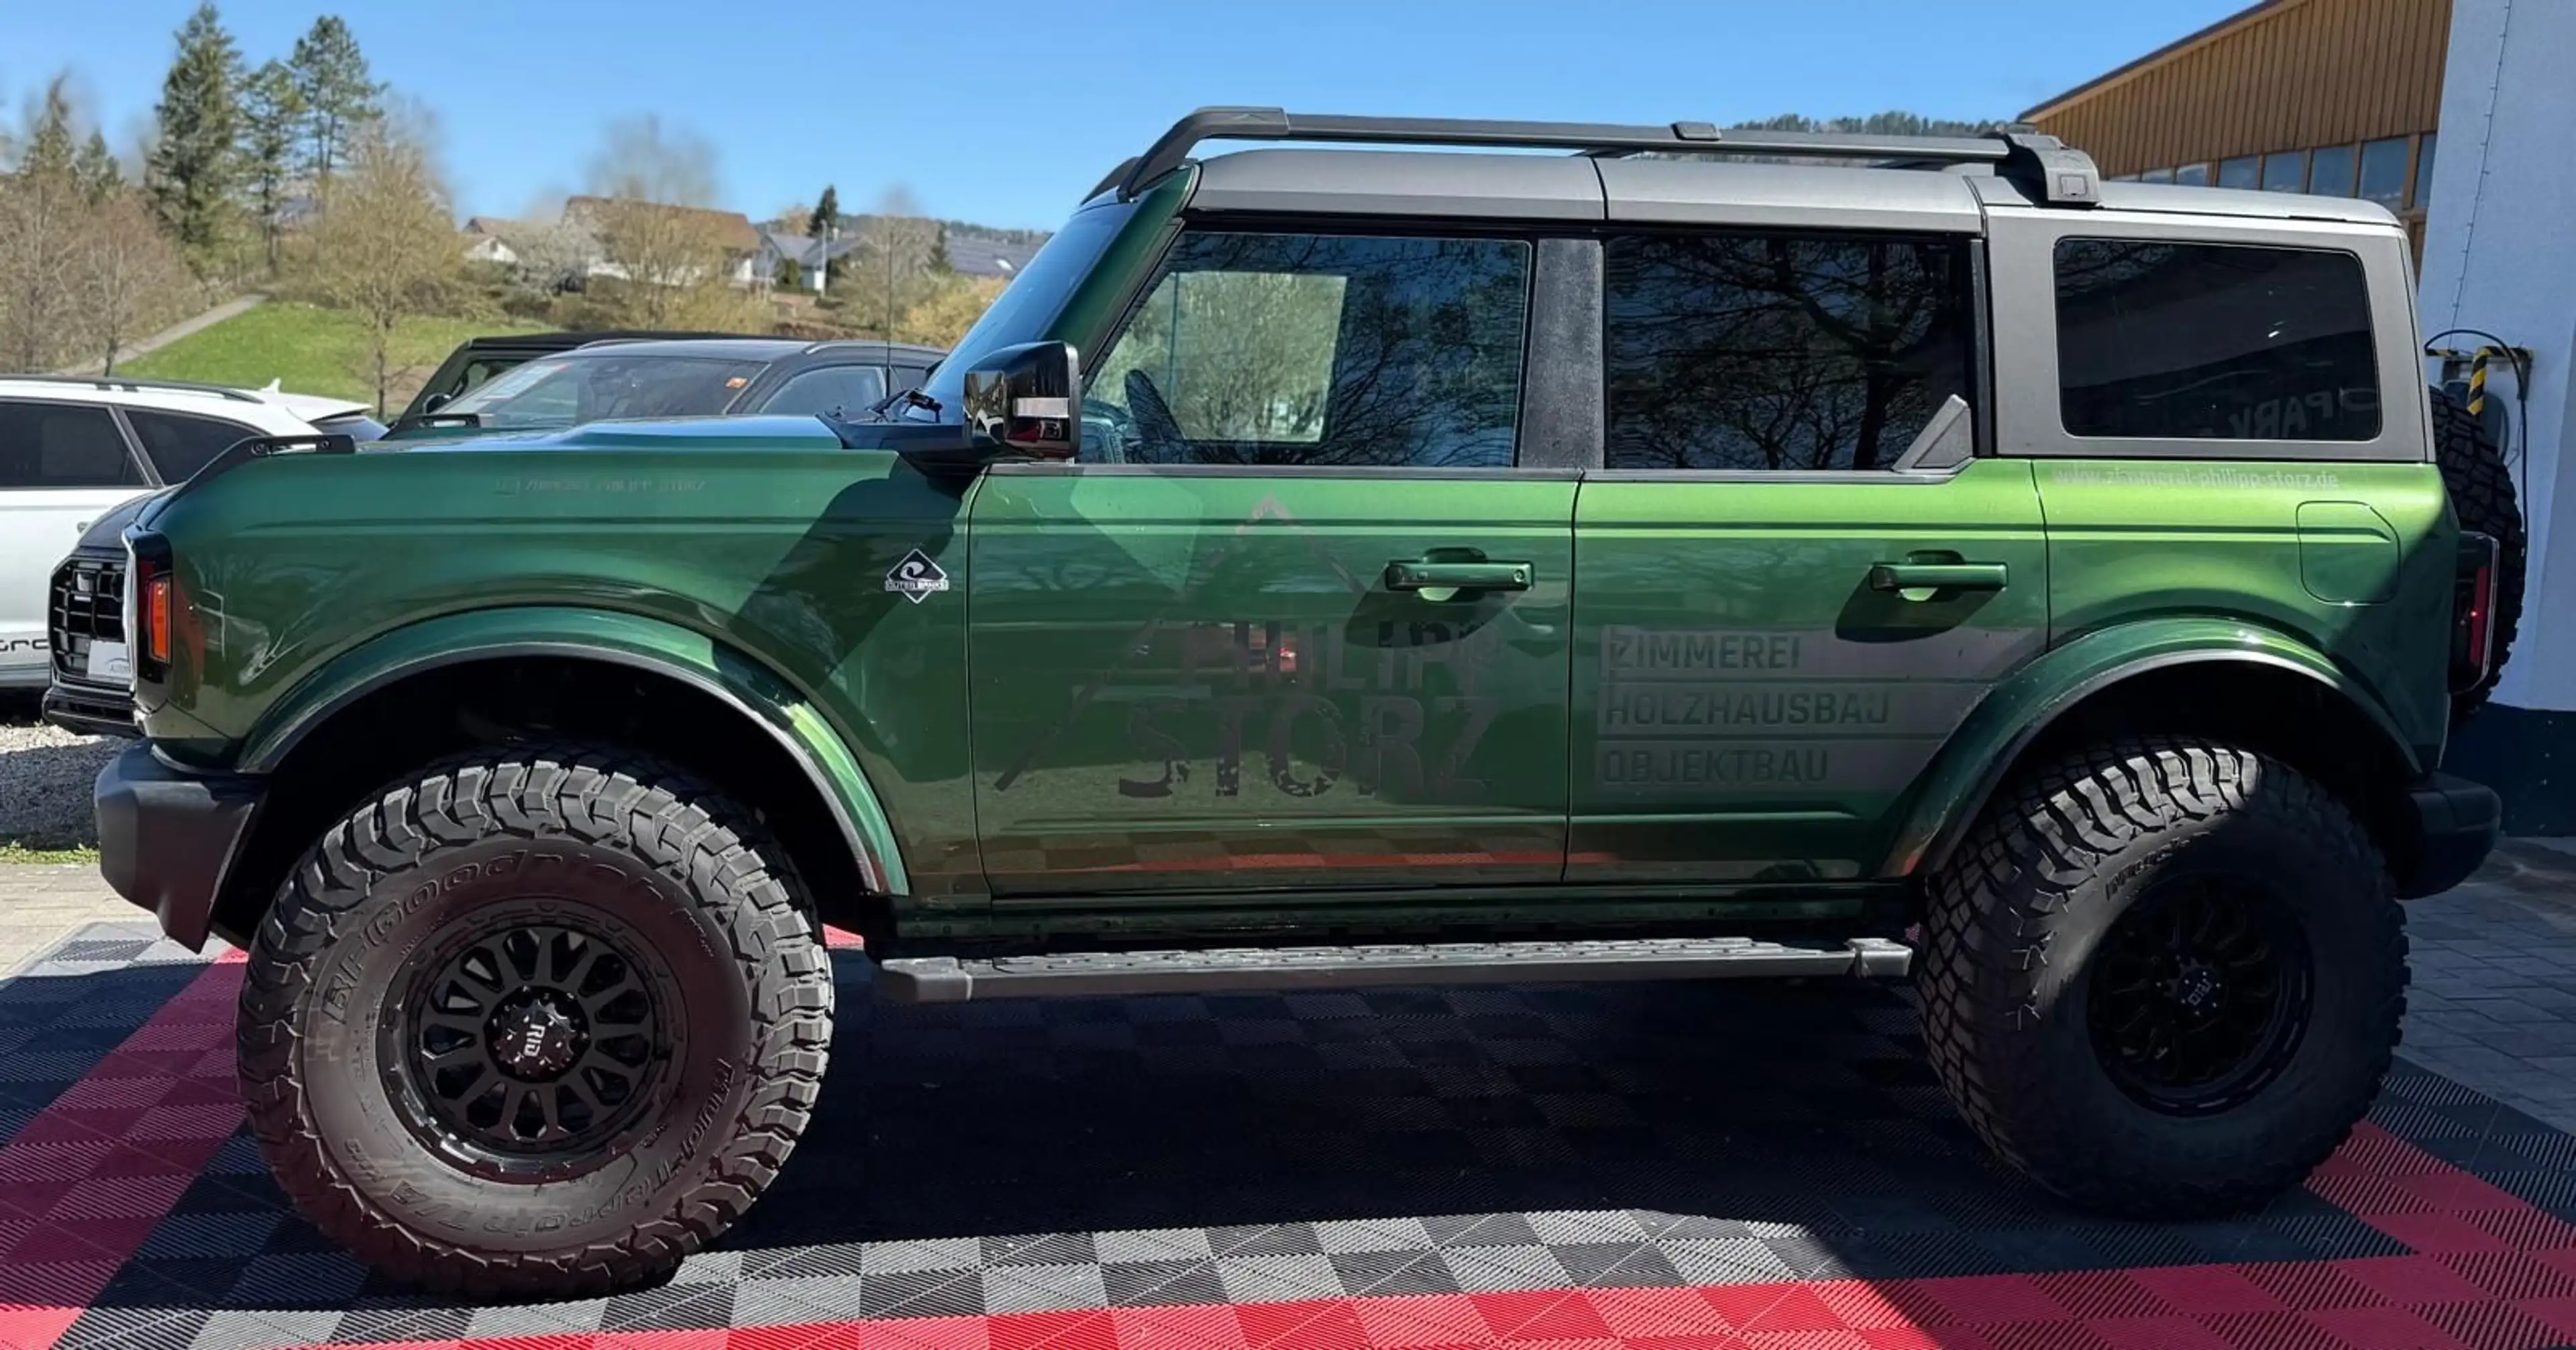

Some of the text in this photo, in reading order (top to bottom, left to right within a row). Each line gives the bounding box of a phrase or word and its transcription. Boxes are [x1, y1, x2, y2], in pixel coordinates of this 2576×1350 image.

[1611, 634, 1801, 669] ZIMMEREI
[1605, 691, 1890, 726] HOLZHAUSBAU
[1118, 695, 1503, 798] STORZ
[1603, 748, 1829, 785] OBJEKTBAU
